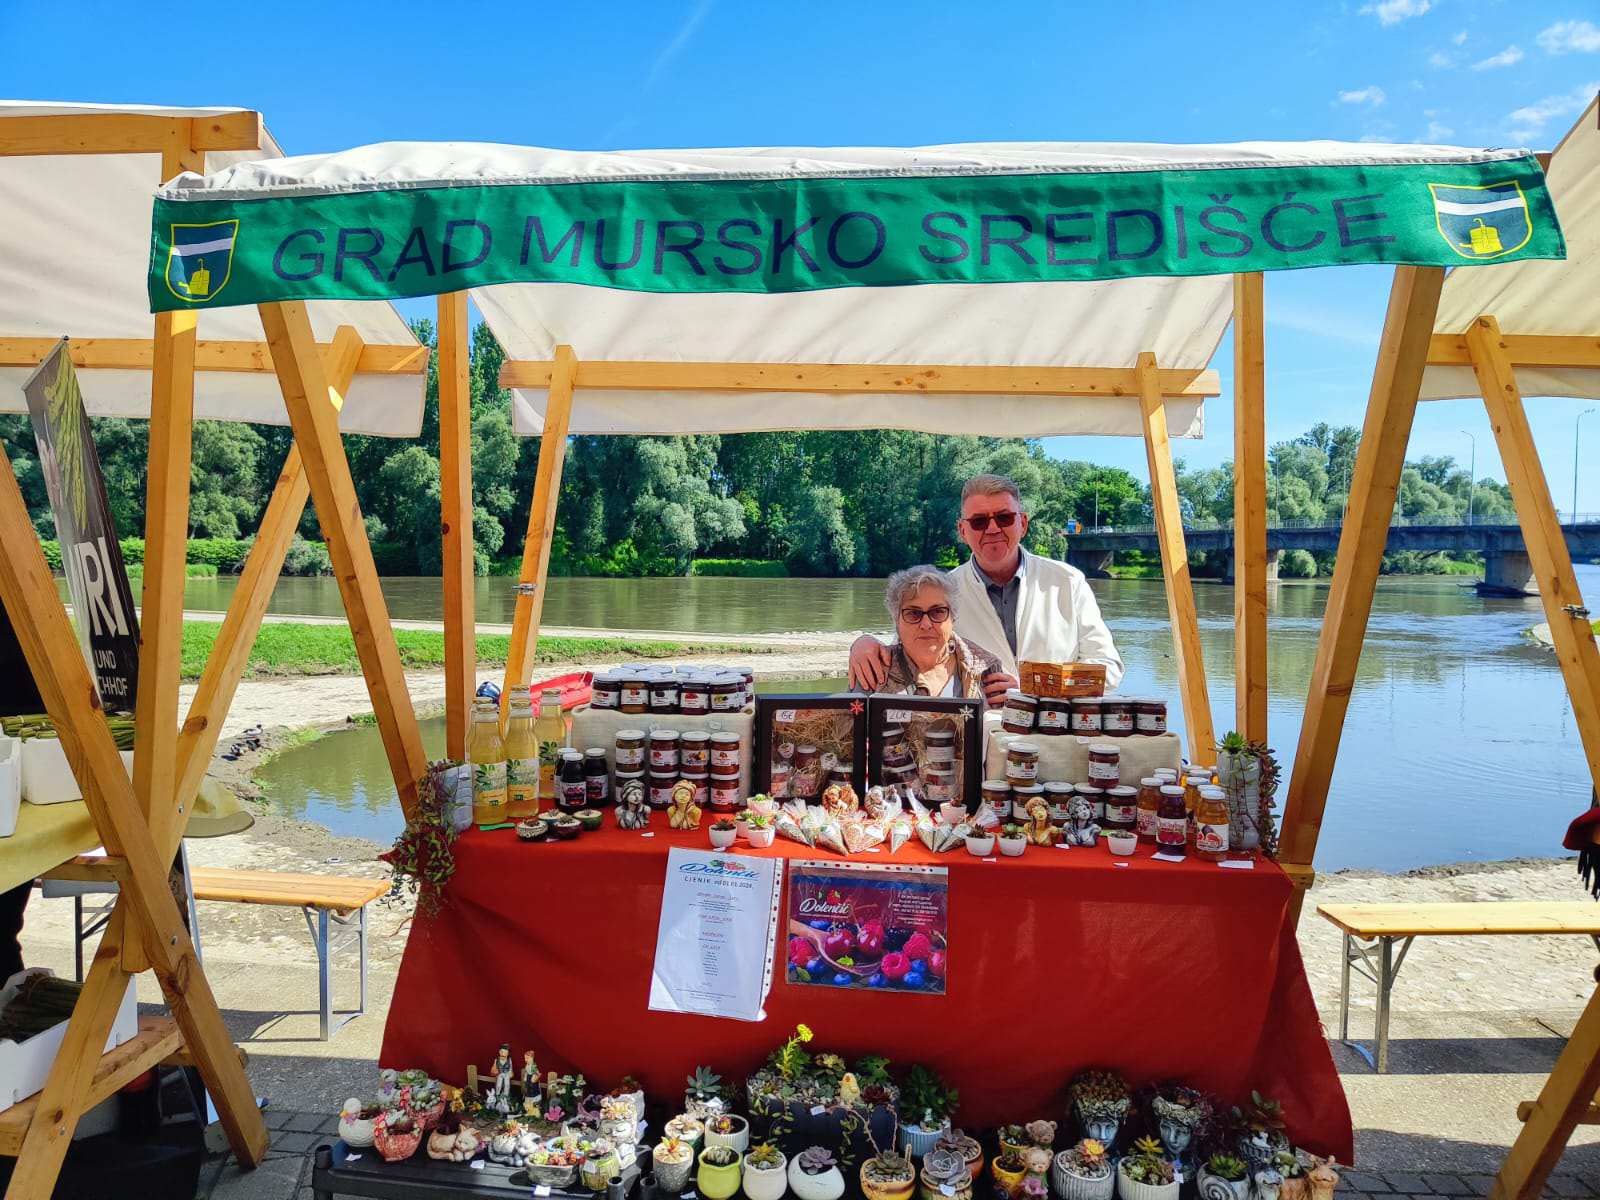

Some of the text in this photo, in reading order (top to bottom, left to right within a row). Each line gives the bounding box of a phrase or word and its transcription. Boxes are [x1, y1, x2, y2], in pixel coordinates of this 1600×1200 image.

[272, 192, 1396, 283] GRAD MURSKO SREDIŠĆE
